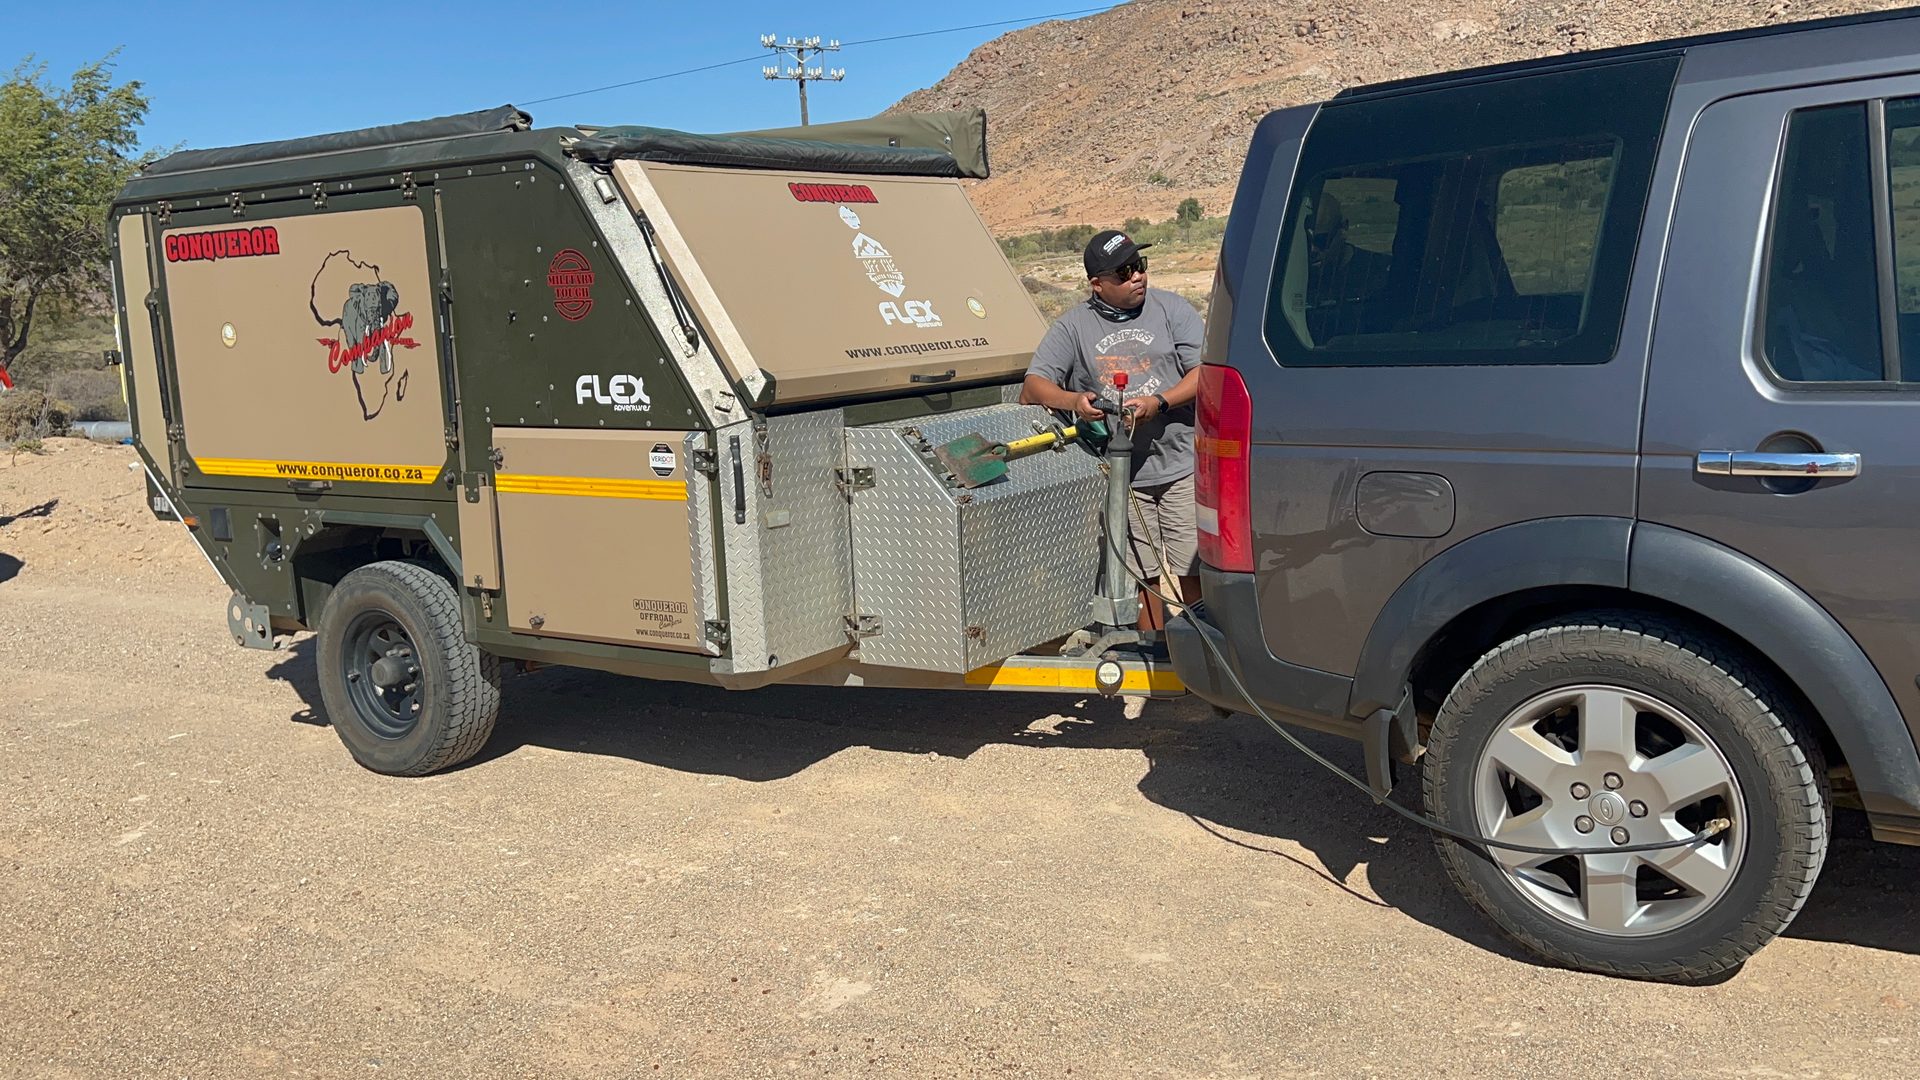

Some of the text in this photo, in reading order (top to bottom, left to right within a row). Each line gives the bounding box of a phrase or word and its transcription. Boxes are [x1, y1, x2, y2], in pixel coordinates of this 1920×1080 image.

[788, 183, 879, 204] CONQUEROR
[165, 226, 280, 262] CONQUEROR
[547, 273, 594, 286] MILITARY
[555, 287, 590, 299] TOUGH
[878, 300, 941, 326] FLEX
[328, 312, 414, 374] Companion
[845, 337, 989, 359] www.conqueror.co.za
[575, 374, 651, 404] FLEX
[276, 463, 424, 481] www.conqueror.co.za
[633, 598, 688, 614] CONQUEROR
[640, 612, 673, 622] OFFROAD
